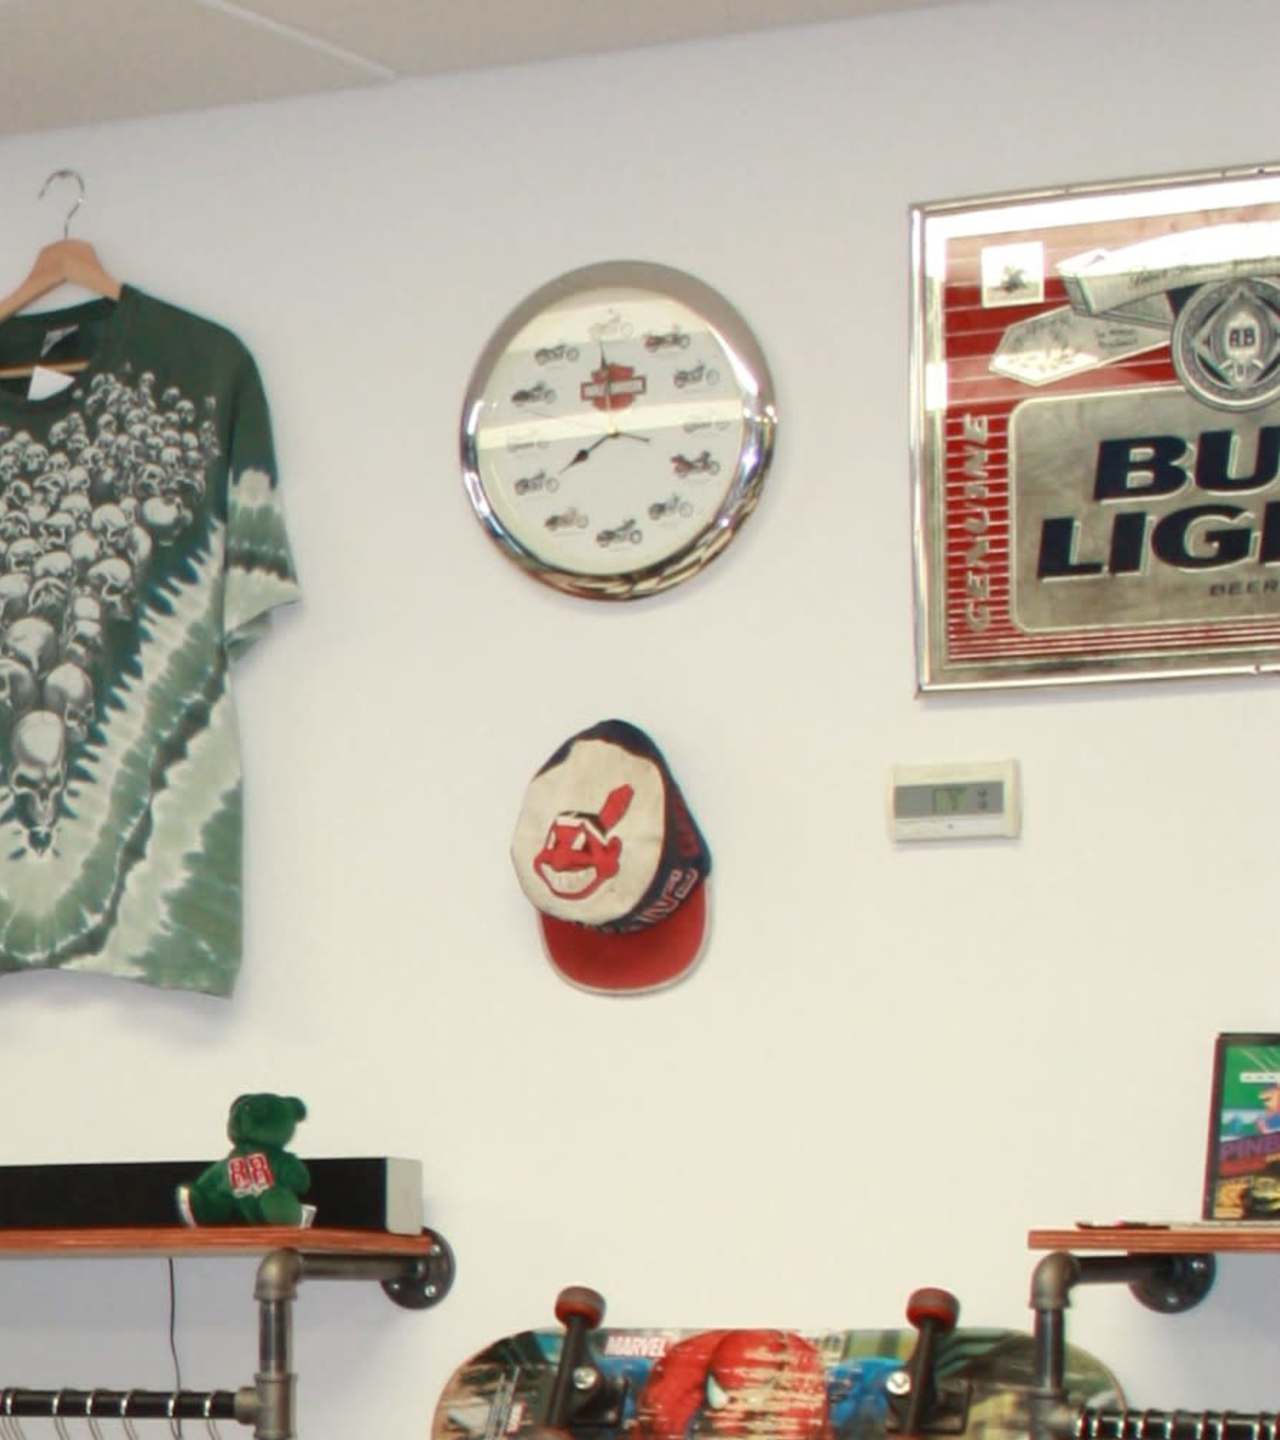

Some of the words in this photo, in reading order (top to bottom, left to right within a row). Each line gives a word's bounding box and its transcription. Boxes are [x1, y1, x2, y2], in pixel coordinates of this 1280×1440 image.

[962, 412, 991, 633] GENUINE
[228, 1153, 274, 1190] 88
[605, 1336, 667, 1358] MARVEL
